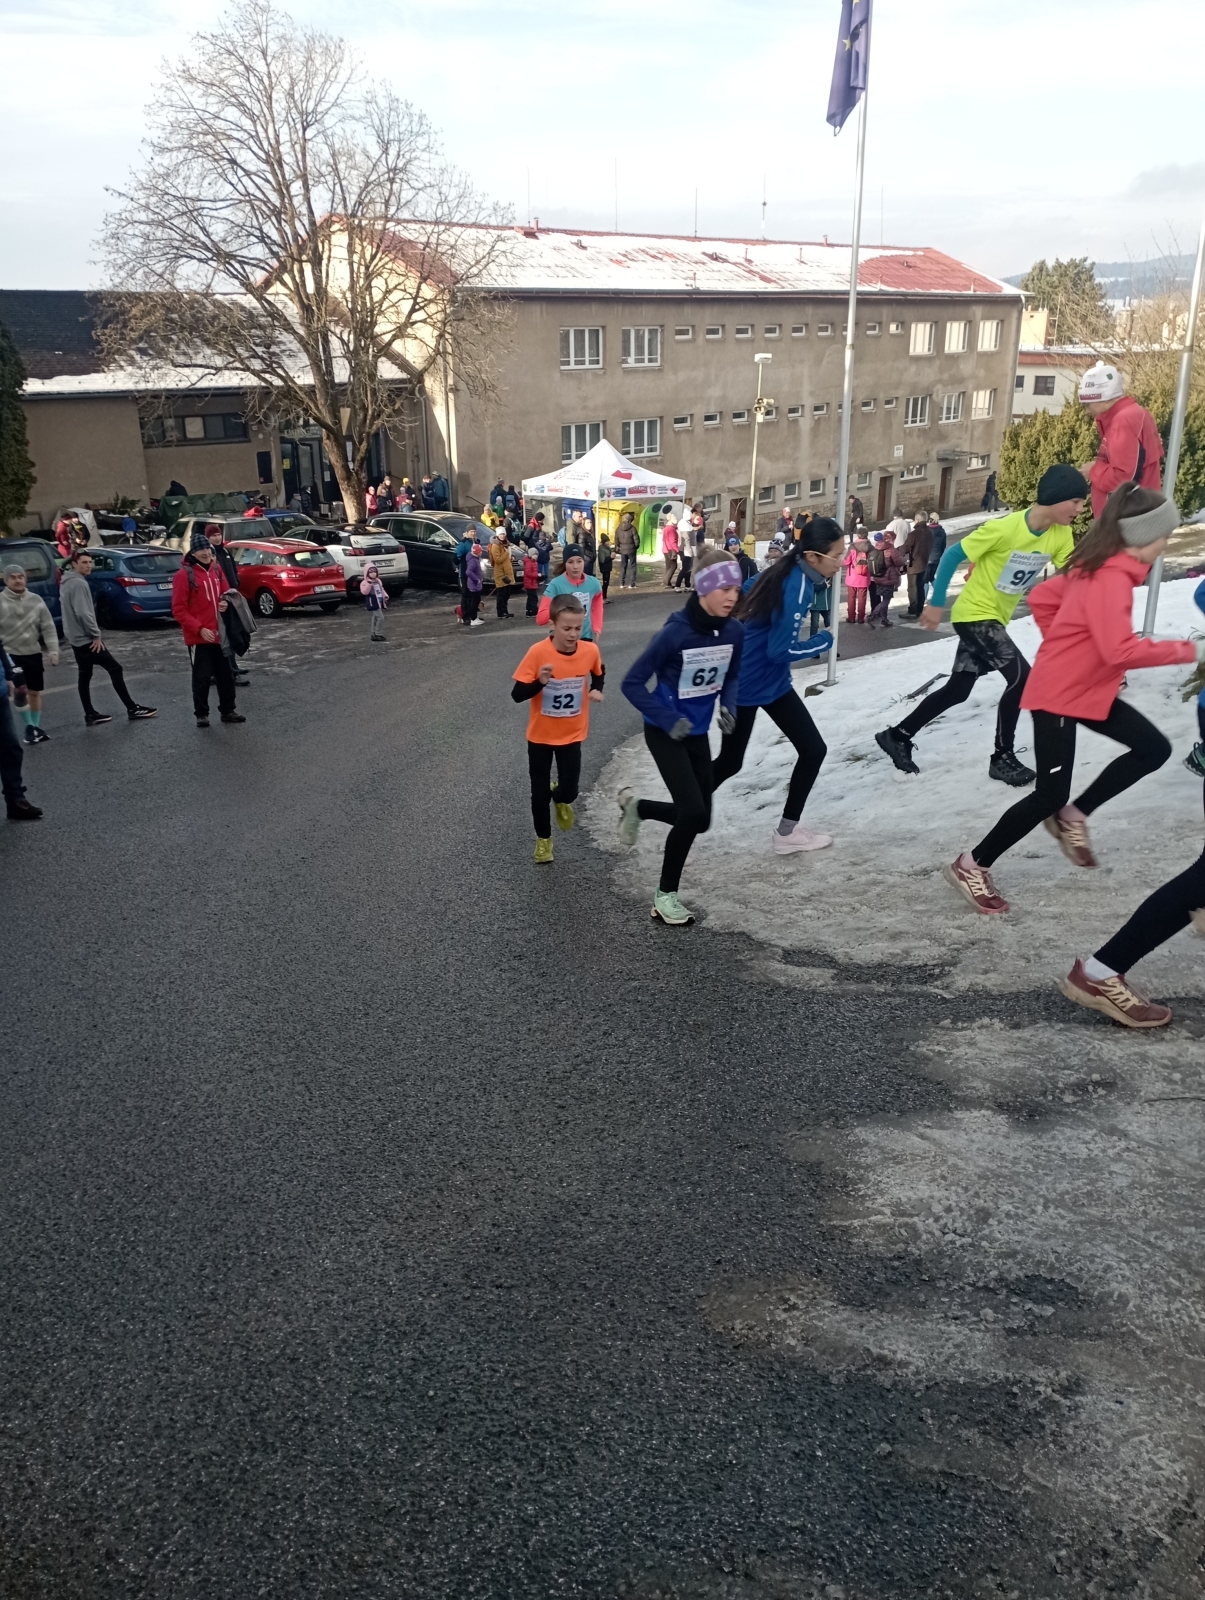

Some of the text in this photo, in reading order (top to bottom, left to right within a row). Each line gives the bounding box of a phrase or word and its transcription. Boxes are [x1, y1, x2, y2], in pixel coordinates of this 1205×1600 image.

[1010, 569, 1037, 586] 97
[692, 666, 719, 687] 62
[551, 693, 575, 710] 52
